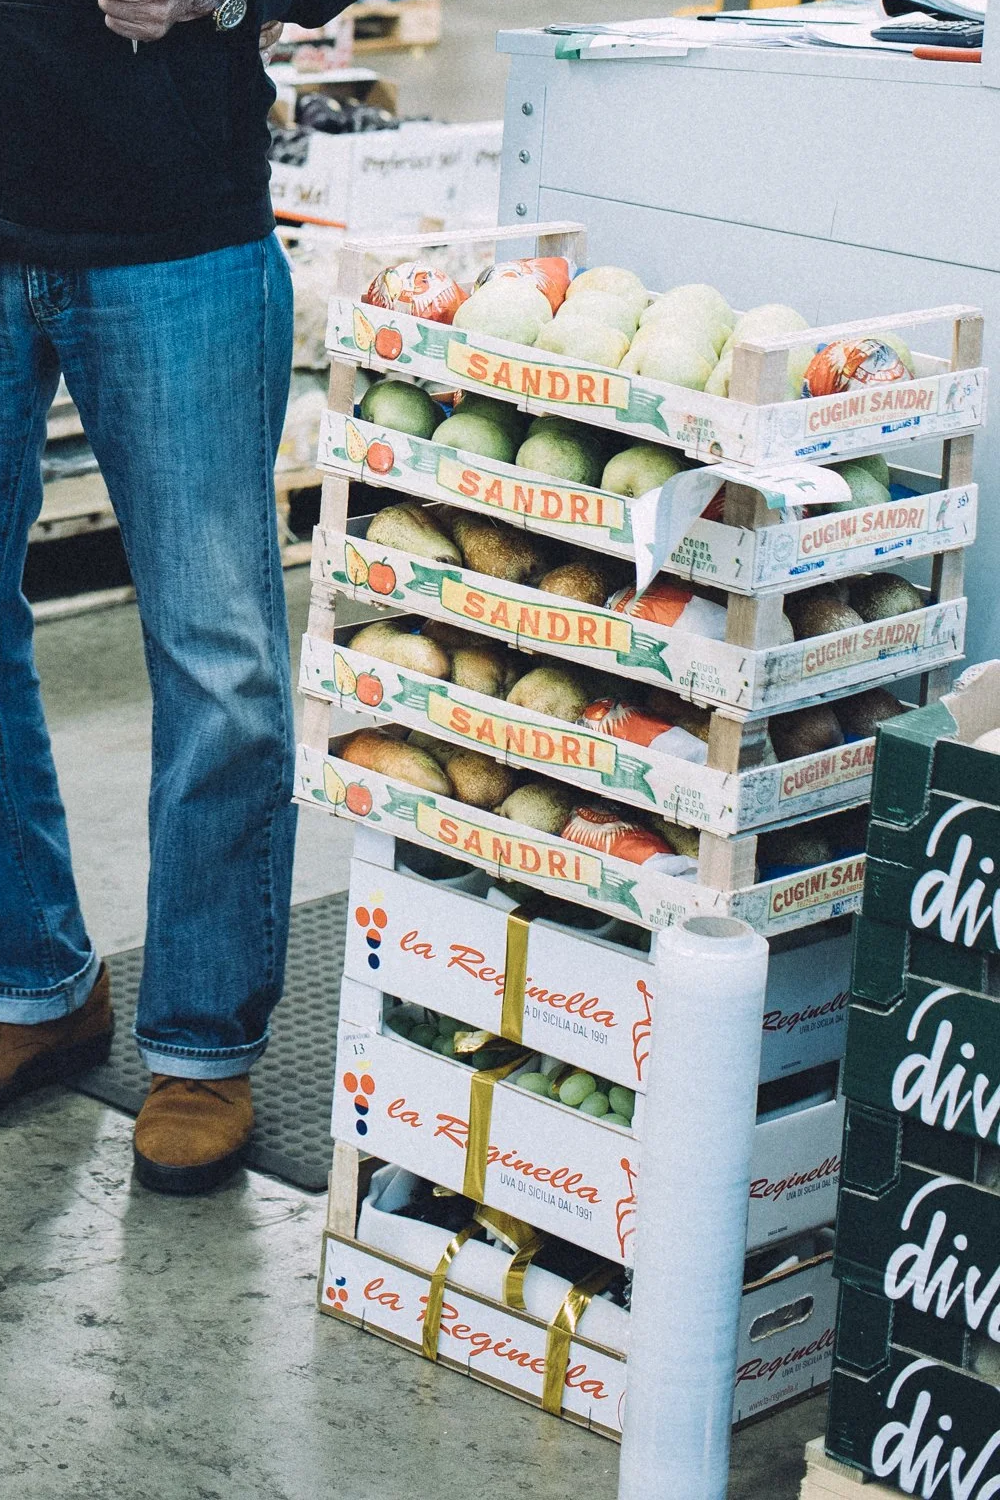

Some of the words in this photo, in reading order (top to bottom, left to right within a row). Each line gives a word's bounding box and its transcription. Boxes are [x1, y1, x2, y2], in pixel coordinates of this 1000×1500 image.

[466, 353, 610, 404] SANDRI
[808, 397, 865, 431] CUGINI
[870, 389, 934, 413] SANDRI
[458, 470, 603, 525] SANDRI
[801, 520, 857, 554] CUGINI
[862, 508, 925, 533] SANDRI
[463, 591, 611, 646] SANDRI
[805, 633, 858, 672] CUGINI
[862, 623, 920, 650] SANDRI
[449, 706, 595, 767] SANDRI
[783, 755, 836, 795] CUGINI
[438, 818, 581, 881] SANDRI
[773, 871, 827, 912] CUGINI
[399, 930, 437, 960] la
[532, 1007, 541, 1020] DI
[542, 1010, 571, 1032] SICILIA
[572, 1021, 588, 1039] DAL
[590, 1028, 609, 1046] 1991
[353, 1043, 366, 1055] 13
[386, 1098, 423, 1128] la
[500, 1173, 517, 1188] UVA
[518, 1178, 527, 1192] DI
[528, 1184, 557, 1204] SICILIA
[557, 1195, 573, 1214] DAL
[575, 1203, 593, 1222] 1991
[363, 1277, 404, 1311] la
